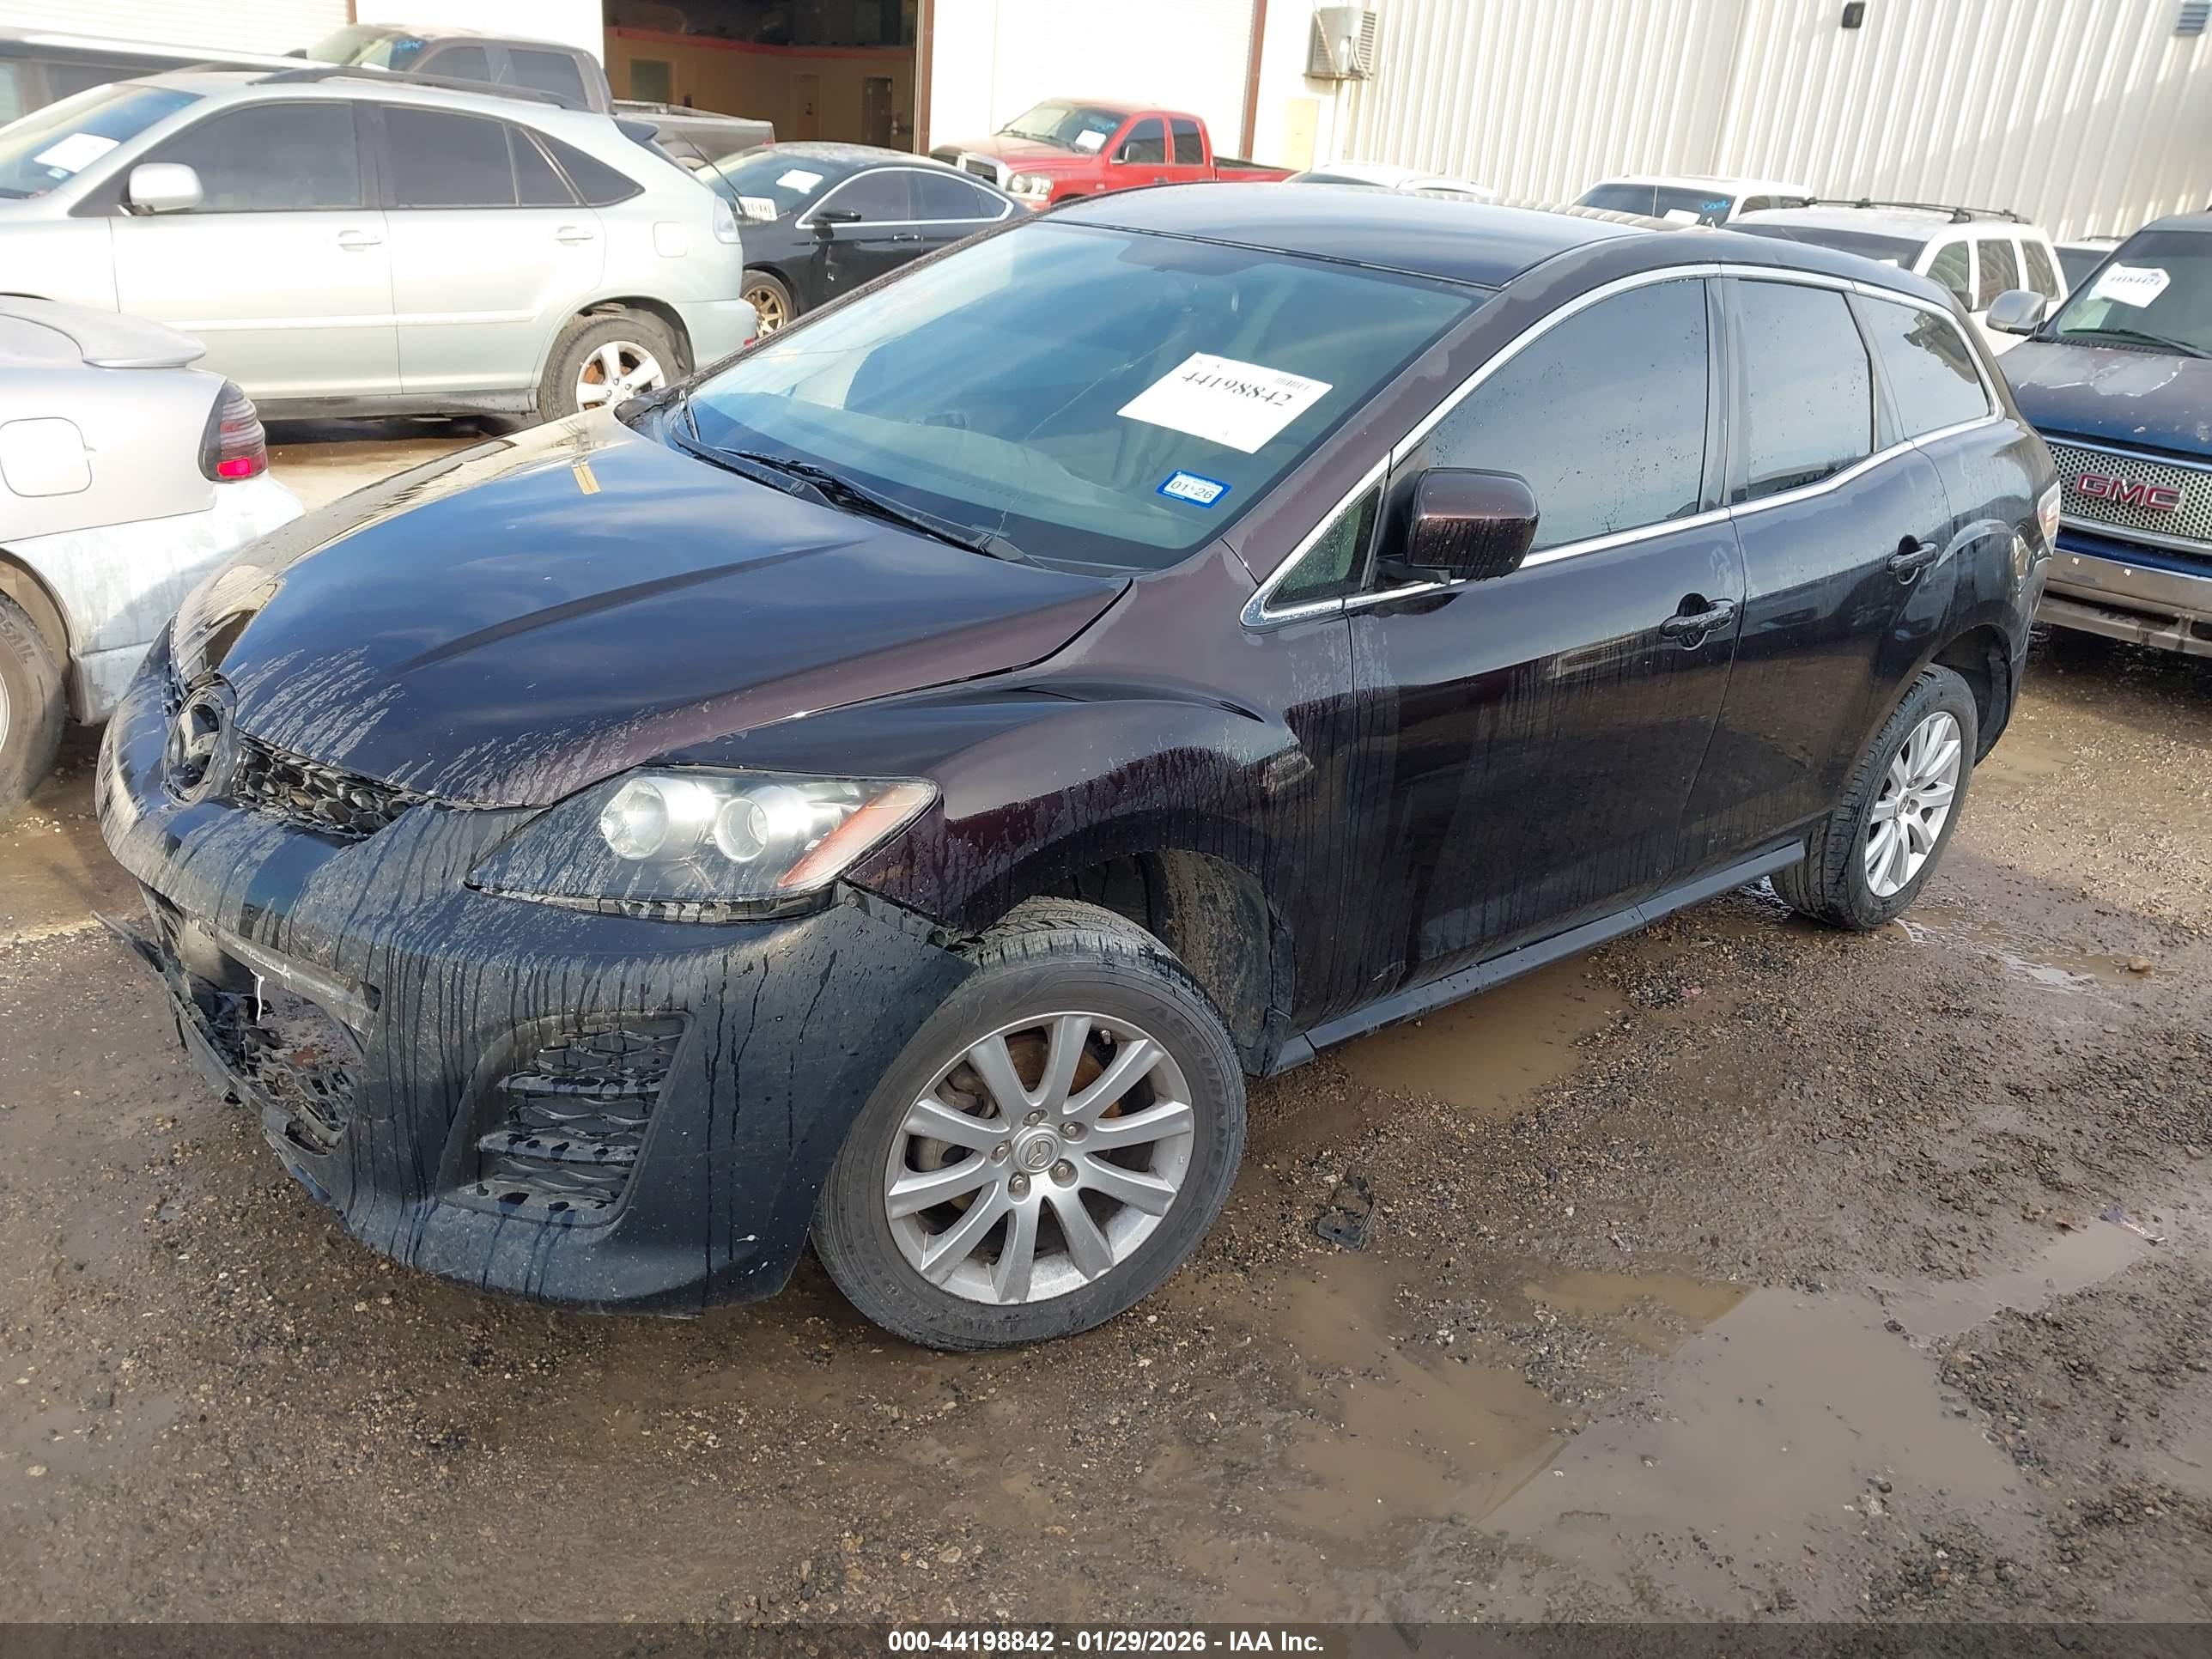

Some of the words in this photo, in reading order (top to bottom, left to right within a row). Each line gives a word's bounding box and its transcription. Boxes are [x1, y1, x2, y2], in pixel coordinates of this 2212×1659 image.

[1182, 371, 1292, 406] 44198842
[1170, 481, 1189, 492] 01
[1194, 488, 1215, 499] 26
[2076, 473, 2184, 513] GMC
